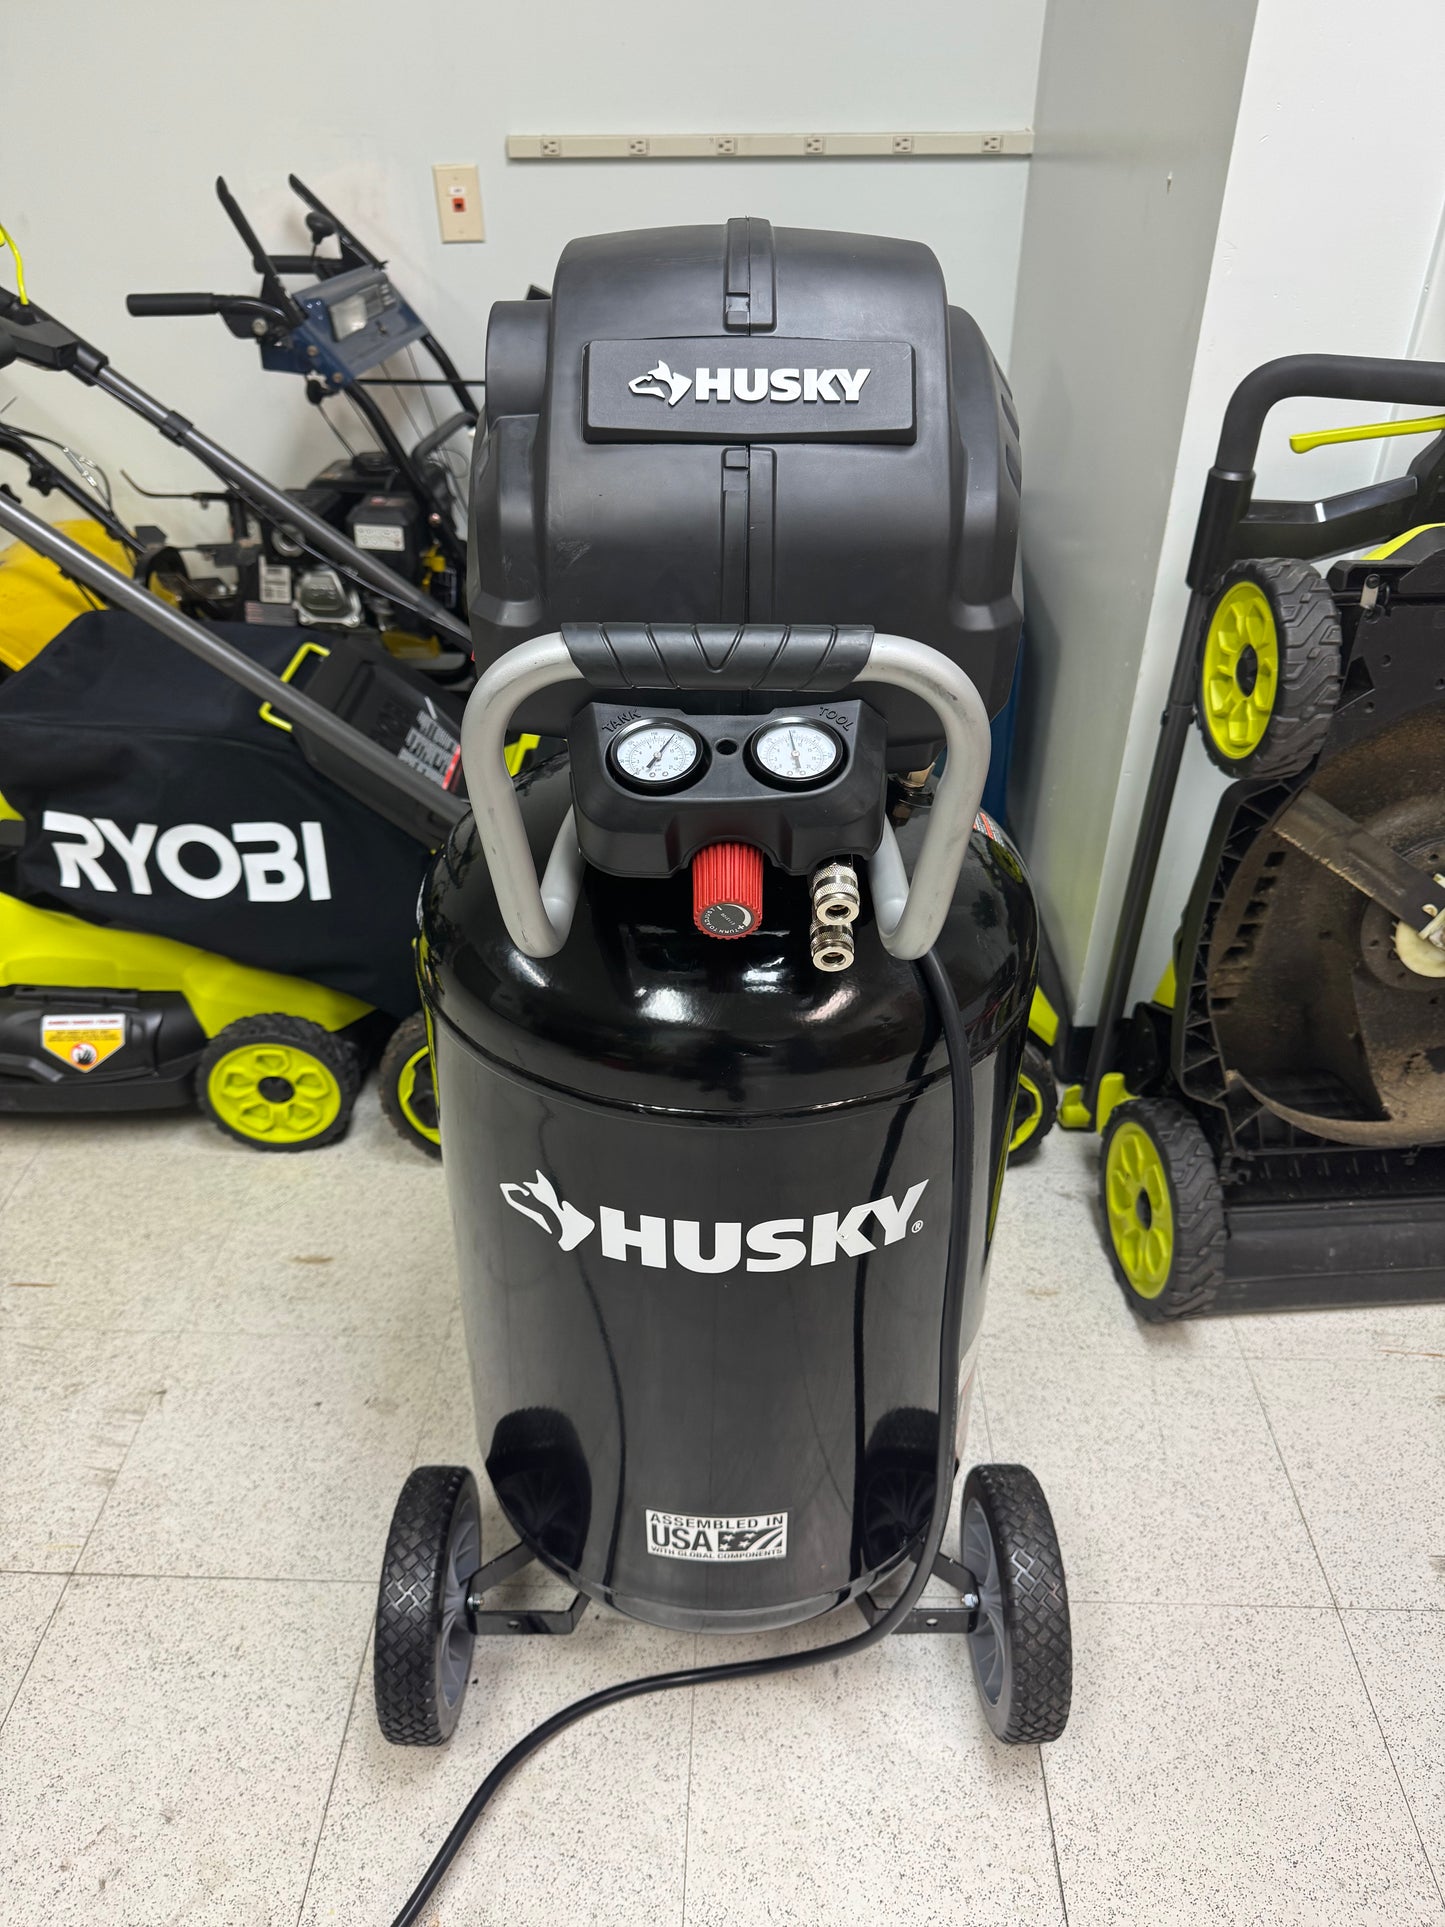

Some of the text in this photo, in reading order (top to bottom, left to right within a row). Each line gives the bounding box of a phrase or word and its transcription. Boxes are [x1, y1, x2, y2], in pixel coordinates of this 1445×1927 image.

[695, 367, 871, 403] HUSKY
[602, 708, 643, 732] TANK
[819, 706, 854, 732] TOOL
[42, 809, 332, 903] RYOBI
[650, 1513, 783, 1529] ASSEMBLED IN
[652, 1523, 713, 1552] USA
[651, 1545, 783, 1559] WITH GLOBAL COMPONENTS
